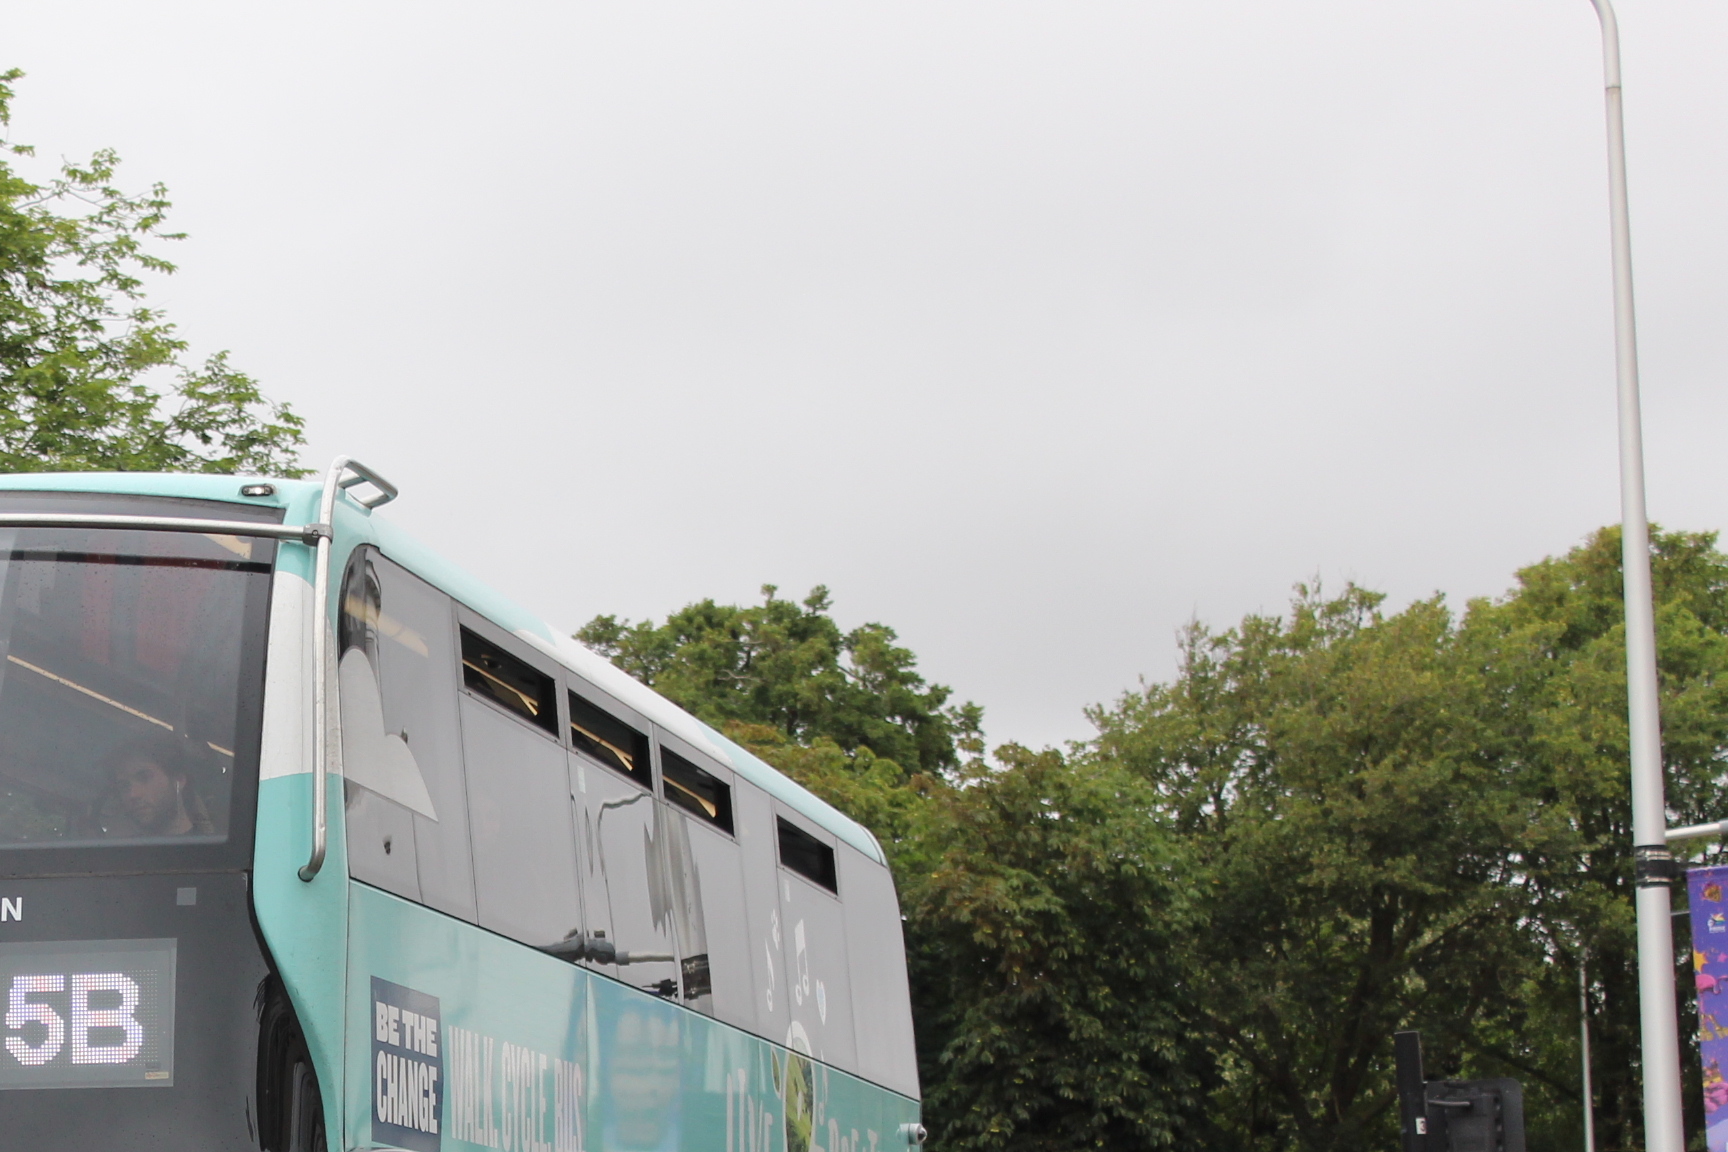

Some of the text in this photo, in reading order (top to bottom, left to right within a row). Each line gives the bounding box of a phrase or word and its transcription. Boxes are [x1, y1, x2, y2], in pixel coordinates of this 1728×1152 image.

[6, 973, 143, 1066] 5B
[375, 1001, 438, 1058] BE THE
[376, 1050, 438, 1134] CHANGE
[448, 1024, 498, 1149] WALK.
